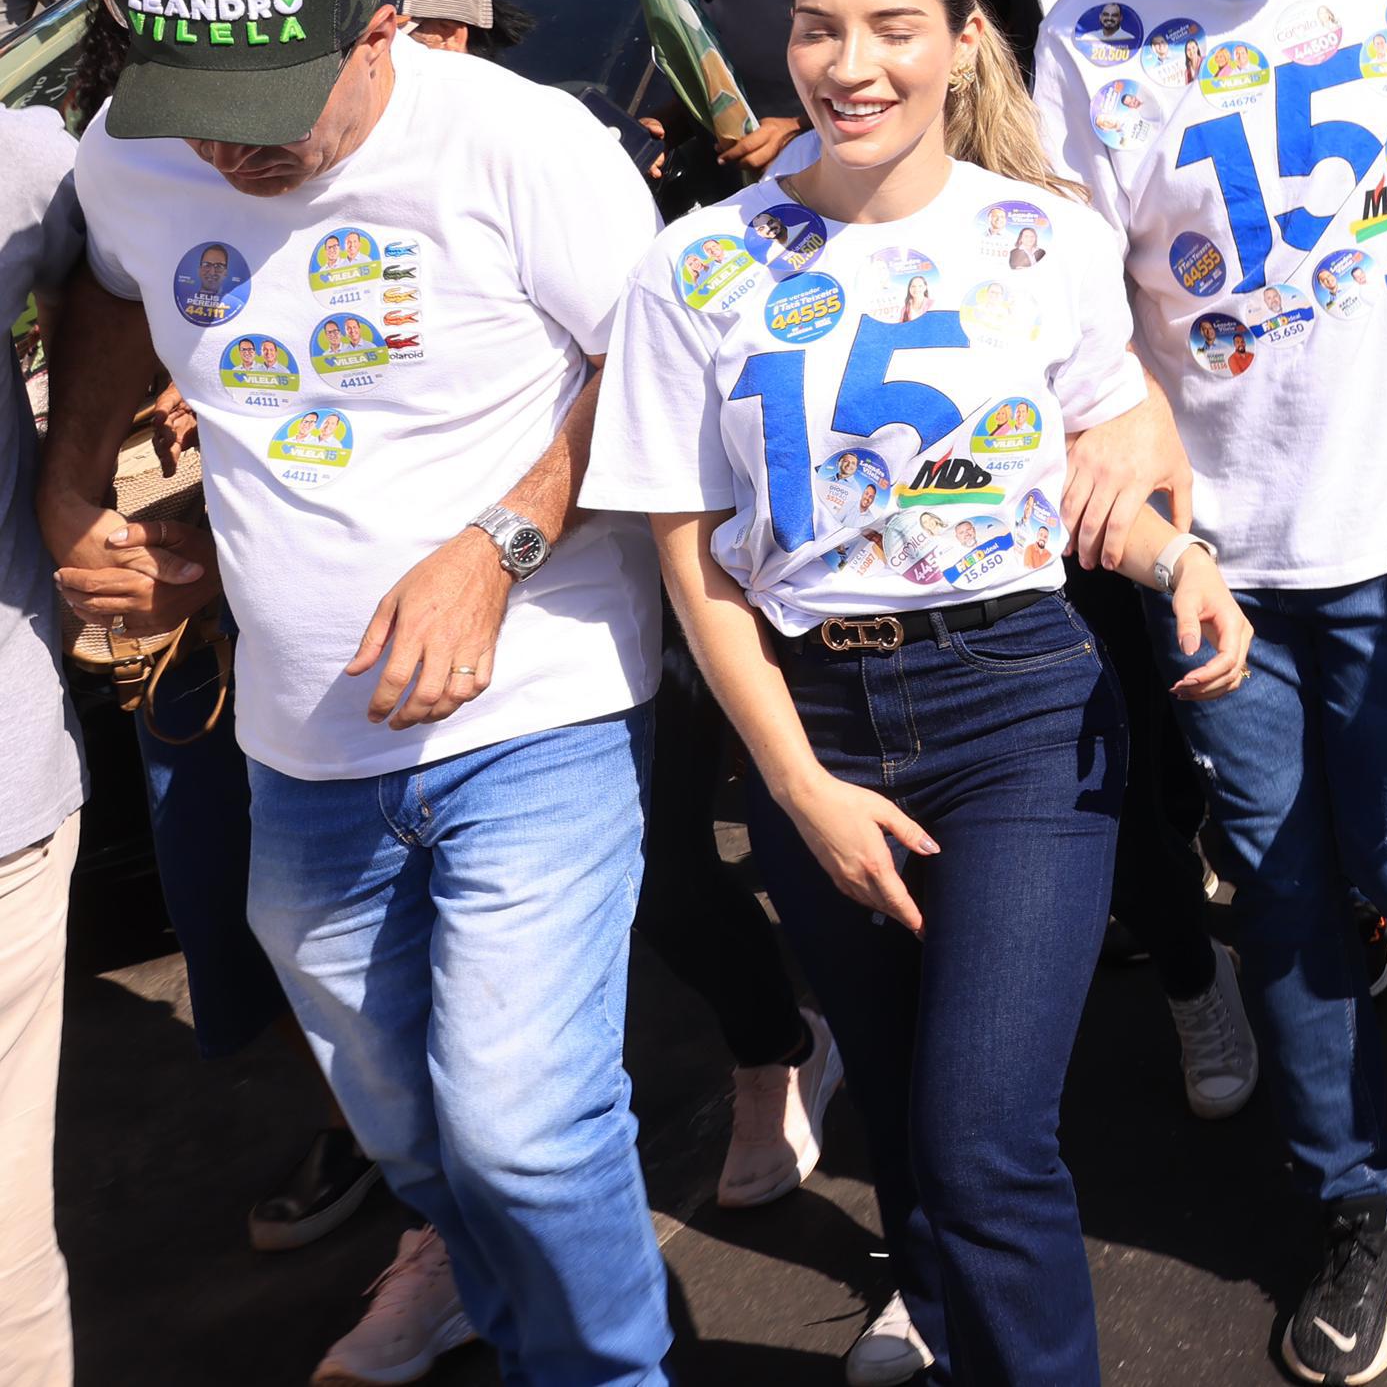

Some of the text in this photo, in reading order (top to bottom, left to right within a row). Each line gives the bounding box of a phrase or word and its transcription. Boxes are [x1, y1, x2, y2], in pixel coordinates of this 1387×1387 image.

[127, 9, 307, 45] VILELA
[1175, 41, 1385, 296] 15
[786, 232, 824, 271] 20.500
[328, 264, 371, 284] VILELA 15
[1183, 248, 1222, 288] 44555
[193, 293, 221, 303] LELIS
[328, 291, 362, 307] 44111
[720, 278, 756, 312] 44180
[788, 286, 821, 301] vereador
[801, 288, 839, 307] Teixeira
[184, 305, 226, 320] 44.111
[186, 298, 226, 309] PEREIRA
[770, 294, 842, 331] 44555
[1267, 322, 1305, 343] 15.650
[333, 350, 378, 368] VILELA 15
[242, 374, 289, 386] VILELA 15
[340, 375, 374, 390] 44111
[244, 395, 280, 408] 44111
[727, 309, 971, 555] 15
[290, 446, 338, 461] VILELA 15
[858, 459, 886, 478] Leandro
[862, 465, 881, 481] Vilela
[985, 460, 1024, 471] 44676
[281, 466, 318, 484] 44111
[828, 484, 850, 496] DIOGO
[963, 553, 1005, 585] 15.650
